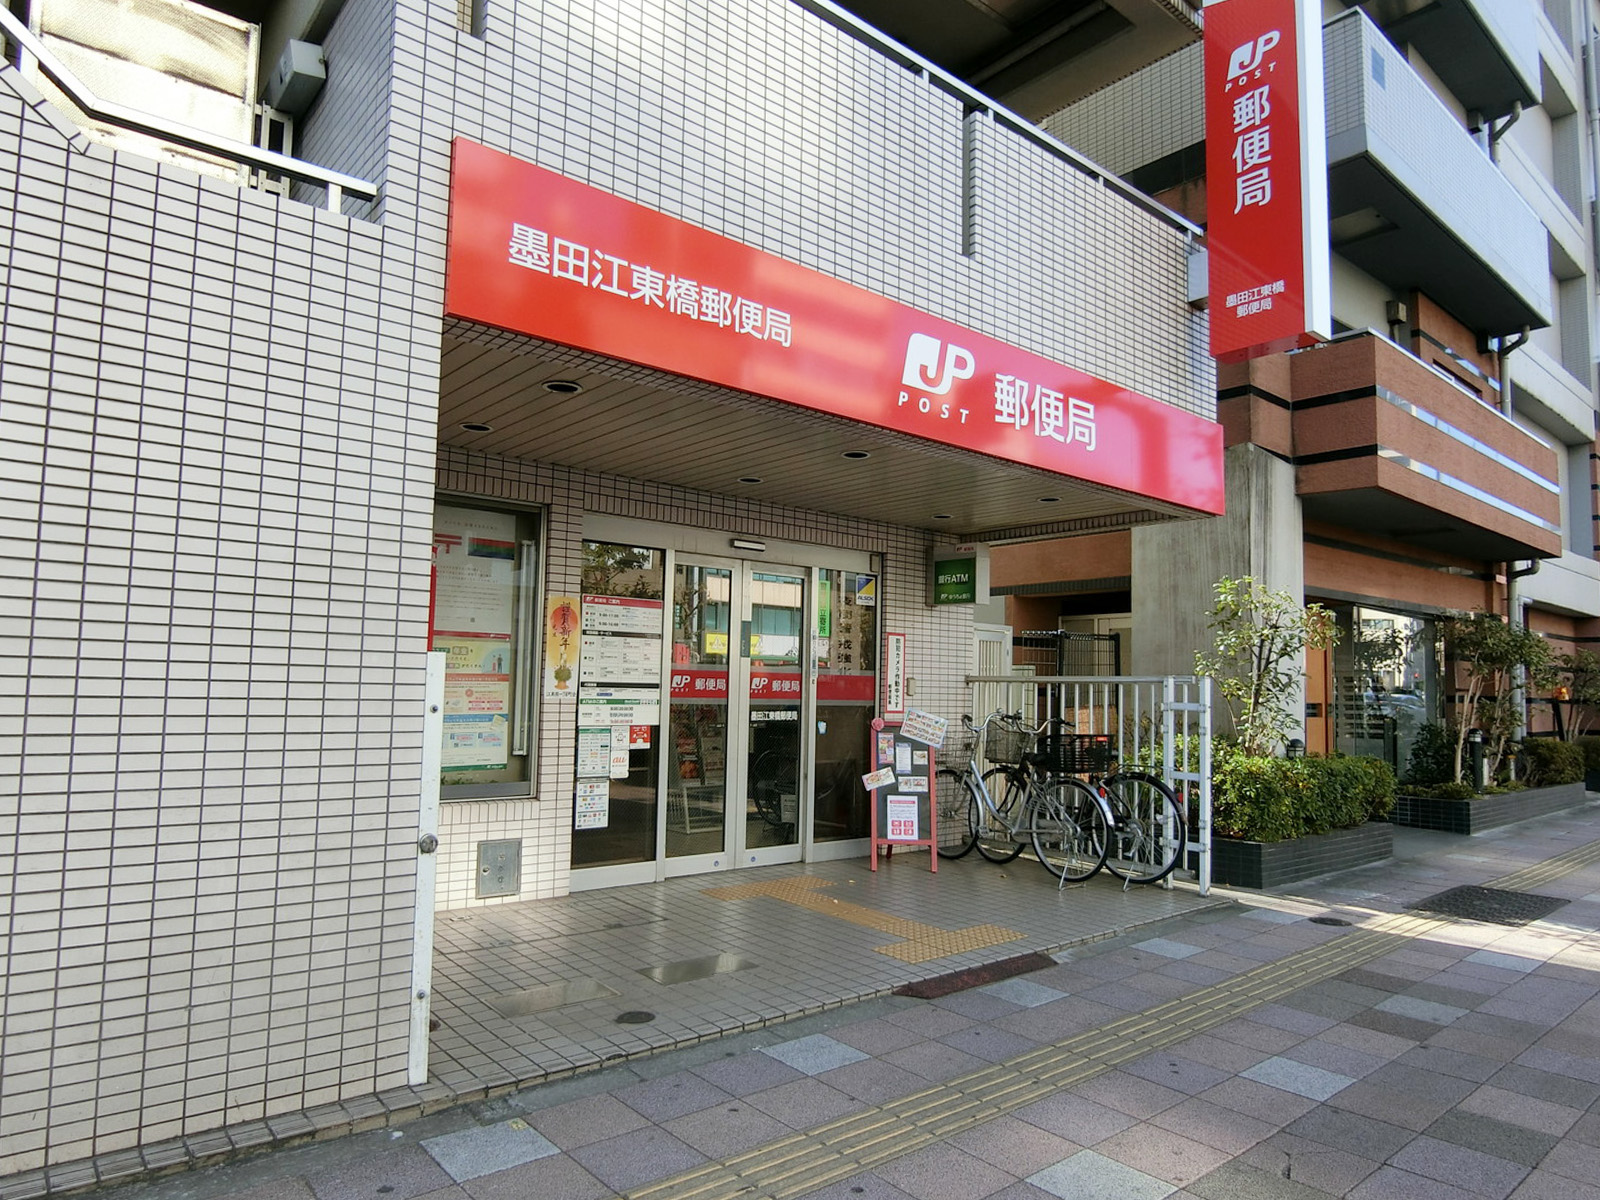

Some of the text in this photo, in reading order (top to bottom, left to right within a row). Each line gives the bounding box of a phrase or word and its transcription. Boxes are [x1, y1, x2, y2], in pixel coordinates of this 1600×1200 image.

[1227, 29, 1281, 81] JP
[1224, 61, 1277, 93] POST
[1231, 84, 1272, 216] 郵便局
[508, 222, 793, 349] 墨田江東橋郵便局
[1225, 278, 1285, 309] 墨田江東橋
[1235, 296, 1273, 319] 郵便局
[901, 332, 976, 396] JP
[898, 391, 970, 424] POST
[993, 372, 1097, 452] 郵便局
[671, 675, 727, 692] JP 郵便局
[750, 677, 800, 693] JP 郵便局
